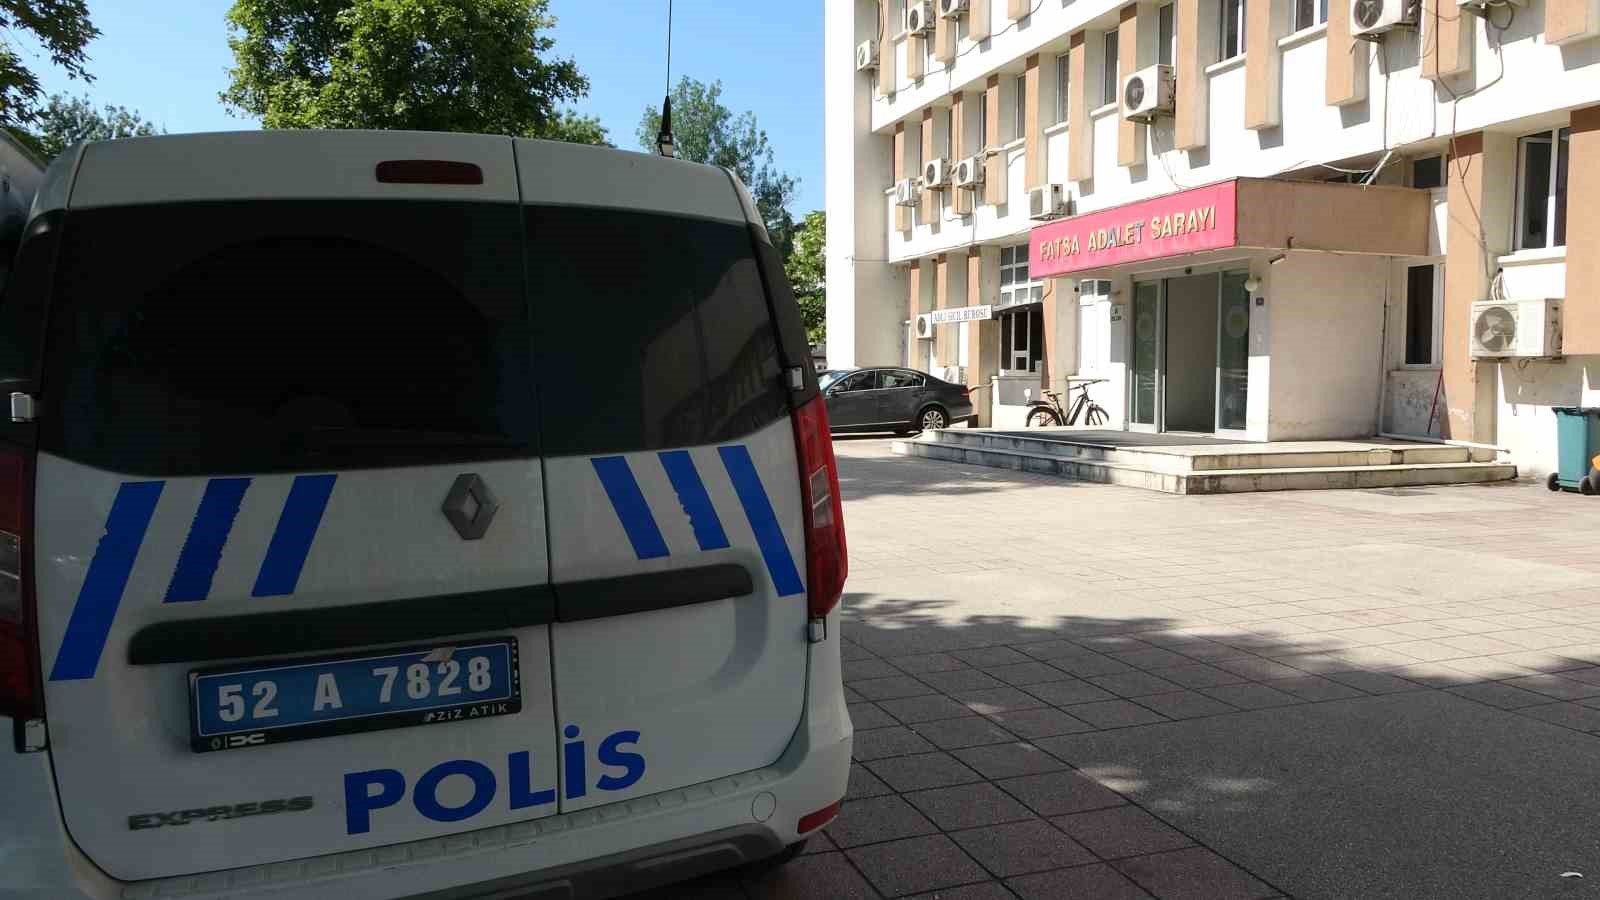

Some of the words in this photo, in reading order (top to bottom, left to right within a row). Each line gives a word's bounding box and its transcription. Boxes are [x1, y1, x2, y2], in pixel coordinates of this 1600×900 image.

[1039, 235, 1081, 262] FATSA
[1087, 221, 1145, 252] ADALET
[1150, 205, 1217, 240] SARAYI
[217, 684, 279, 722] 52
[313, 672, 343, 711] A
[372, 656, 492, 704] 7828
[344, 725, 645, 835] POLİS
[128, 796, 314, 831] EXPRESS
